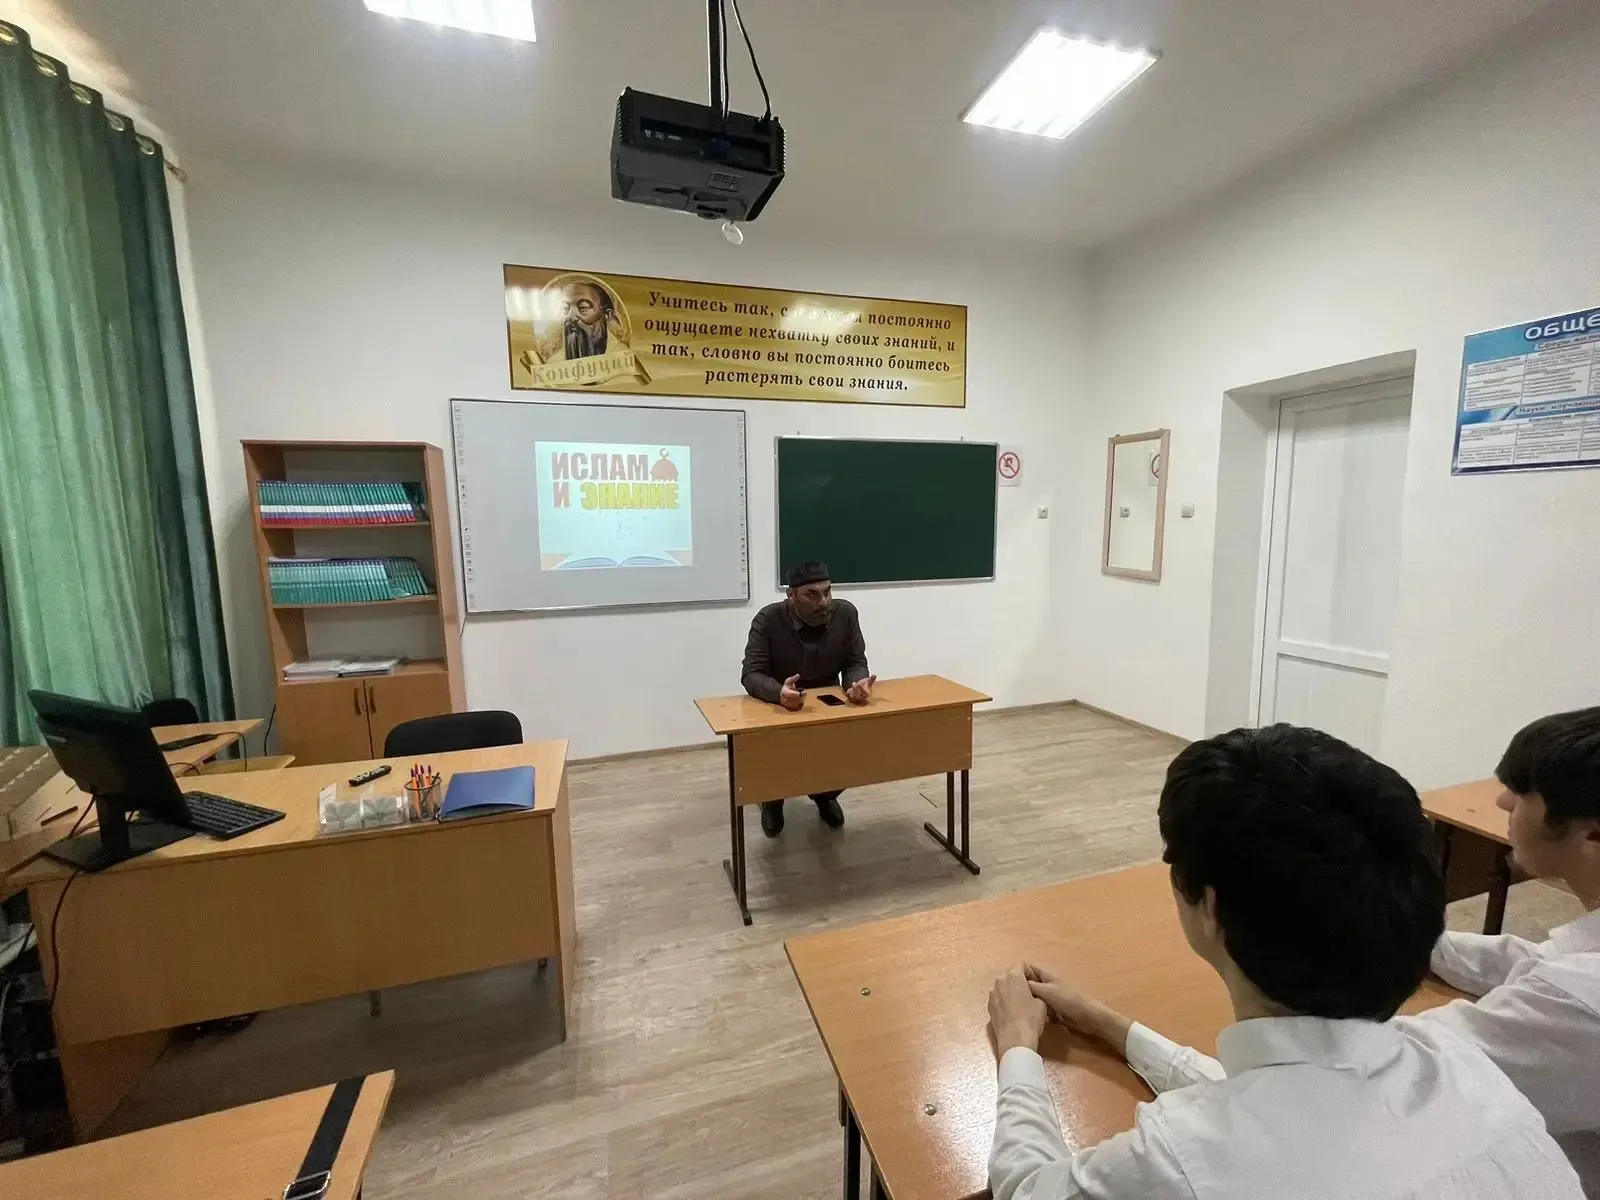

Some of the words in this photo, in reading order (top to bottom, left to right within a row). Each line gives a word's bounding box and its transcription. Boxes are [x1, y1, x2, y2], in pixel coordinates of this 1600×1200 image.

[648, 291, 728, 313] Учитесь
[734, 302, 775, 319] так,
[868, 313, 952, 330] постоянно
[644, 319, 743, 338] ощущаете
[748, 327, 829, 347] нехватку
[836, 334, 880, 347] своих
[884, 335, 942, 352] знаний,
[946, 340, 956, 352] и
[532, 351, 635, 384] Конфуций
[652, 343, 695, 360] так,
[701, 346, 761, 361] словно
[767, 351, 789, 363] вы
[795, 352, 883, 369] постоянно
[888, 355, 951, 372] боитесь
[704, 370, 803, 388] растерять
[808, 375, 844, 388] свои
[849, 377, 908, 391] знания.
[551, 452, 649, 481] ИСЛАМ
[553, 481, 571, 509] И
[580, 482, 680, 511] ЗНАНИЕ
